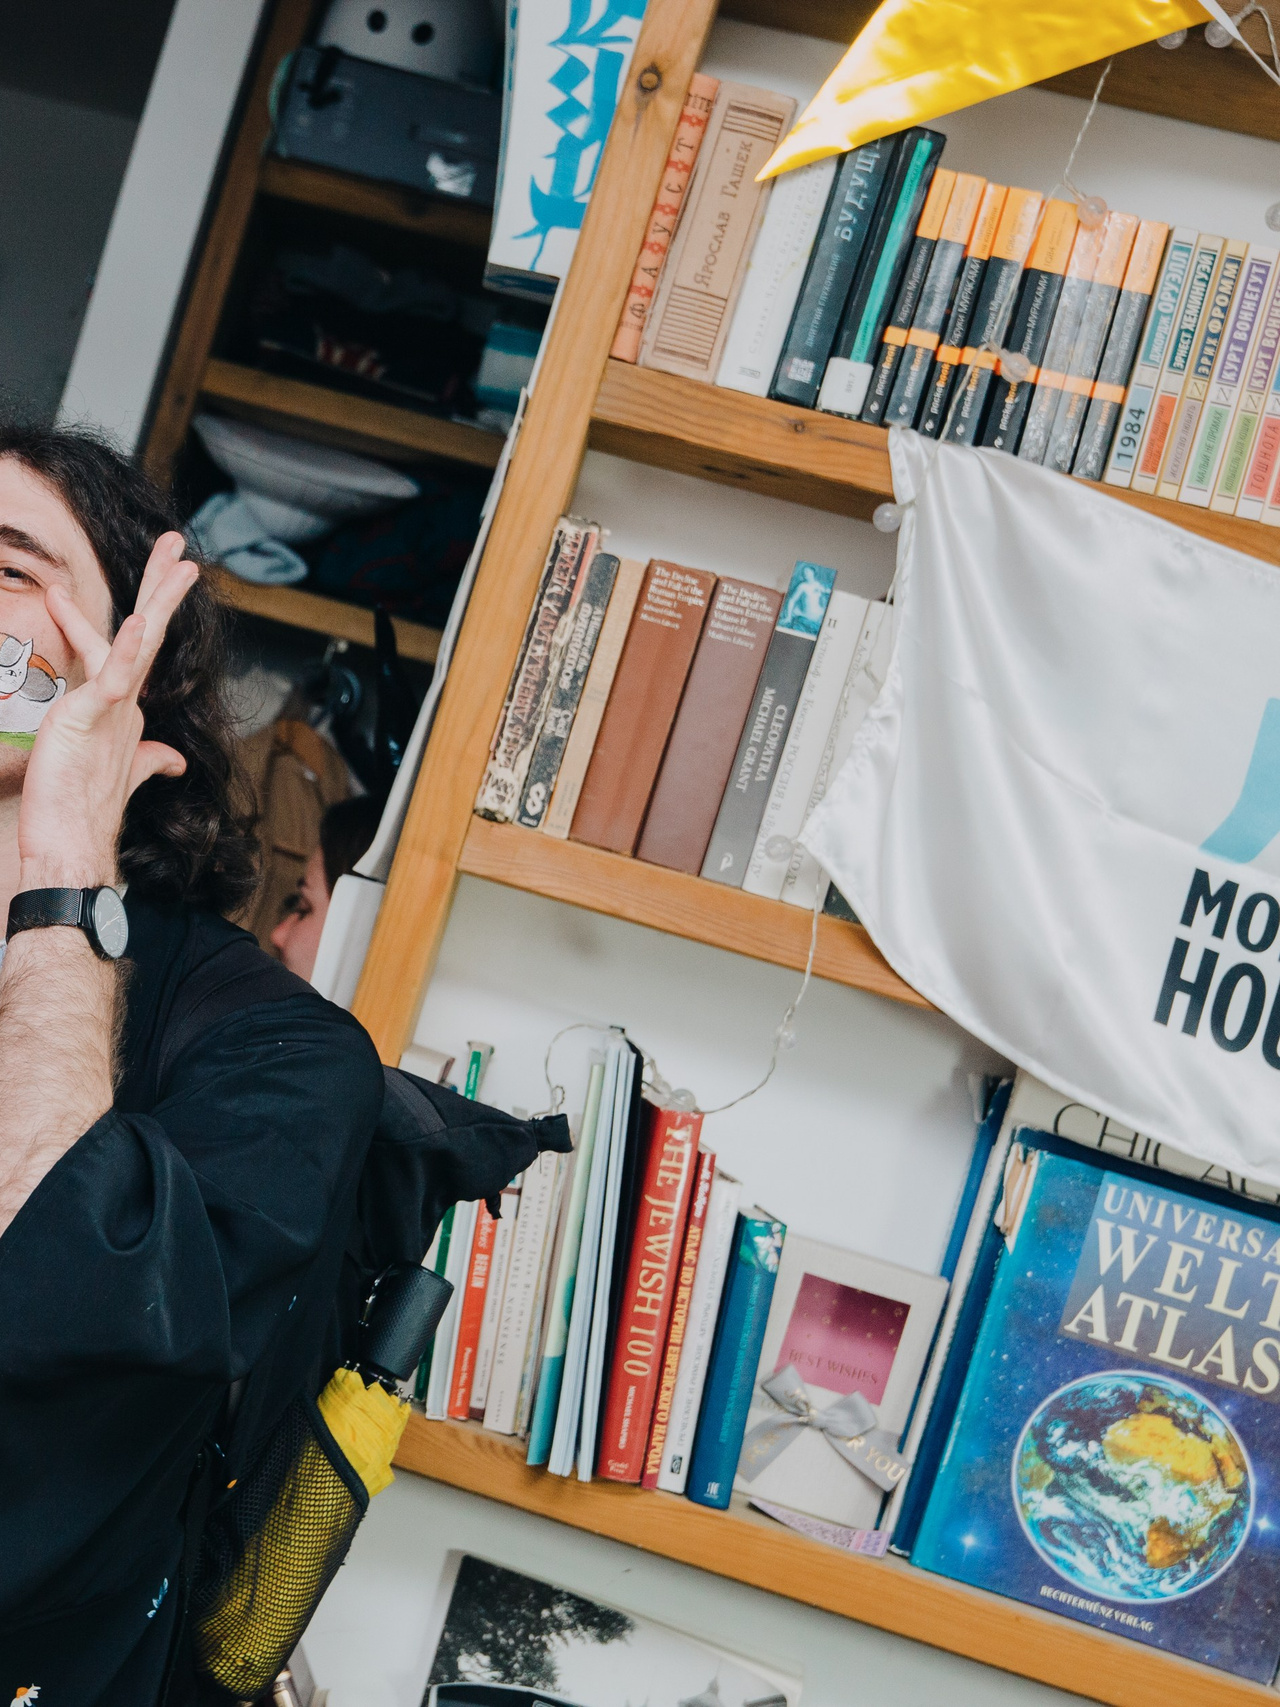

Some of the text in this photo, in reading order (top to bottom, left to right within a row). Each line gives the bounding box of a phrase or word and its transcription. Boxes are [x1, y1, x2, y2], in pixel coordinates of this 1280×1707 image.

[691, 138, 754, 288] ЯРОСЛАВ ГАШЕК
[832, 133, 885, 242] БУДУЩ
[626, 135, 697, 320] ФАУСТ
[896, 243, 928, 324] Харуки Мураками
[948, 258, 980, 346] Харуки МУРАКАМИ
[1148, 248, 1188, 363] ДЖОРДЖ ОРУЭЛЛ
[1171, 252, 1214, 369] ЭРНЕСТ ХЕМИНГУЭЙ
[1019, 274, 1049, 355] аруки МУРАКАМИ
[1197, 259, 1238, 374] ЭРИХ ФРОММ
[1220, 263, 1266, 381] КУРТ ВОННЕГУТ
[873, 343, 896, 396] pocketbook
[902, 346, 925, 398] pocketbook
[929, 361, 951, 414] pocketbook
[959, 366, 982, 418] pocketbook
[1250, 351, 1272, 389] КУРТ
[997, 380, 1019, 430] pocketboo
[1206, 409, 1223, 444] ПРОМАХ
[1115, 405, 1146, 463] 1984
[1168, 403, 1196, 478] ИСКУССТВО ЛЮБИТЬ
[1204, 443, 1214, 454] НЕ
[1251, 425, 1278, 490] ТОШНОТА
[649, 585, 705, 607] Roman Empire
[655, 566, 699, 585] The Decline
[721, 582, 767, 602] The Decline
[716, 601, 774, 623] Roman Empire
[733, 686, 776, 793] MICHAEL GRANT
[753, 703, 788, 783] CLEOPATRA
[792, 697, 814, 741] Кюстин
[773, 742, 800, 799] РОССИЯ
[769, 800, 782, 811] В
[1179, 867, 1280, 953] MO
[509, 1195, 532, 1289] FASHIONABLE
[621, 1122, 692, 1378] THE JEWISH 100
[1103, 1184, 1280, 1267] UNIVERSA
[470, 1252, 489, 1289] BERLIN
[495, 1295, 515, 1366] NONSENSE
[698, 1302, 711, 1337] АВТОРЫ
[1064, 1284, 1280, 1394] ATLAS
[645, 1224, 701, 1476] АТЛАС ПО ИСТОРИИ ЕВРЕЙСКОГО НАРОДА
[788, 1349, 879, 1384] BEST WISHES
[624, 1384, 636, 1417] MICHAEL
[617, 1417, 631, 1450] SHAPIRO
[864, 1447, 906, 1482] YOU
[1114, 1611, 1155, 1632] VERLAG
